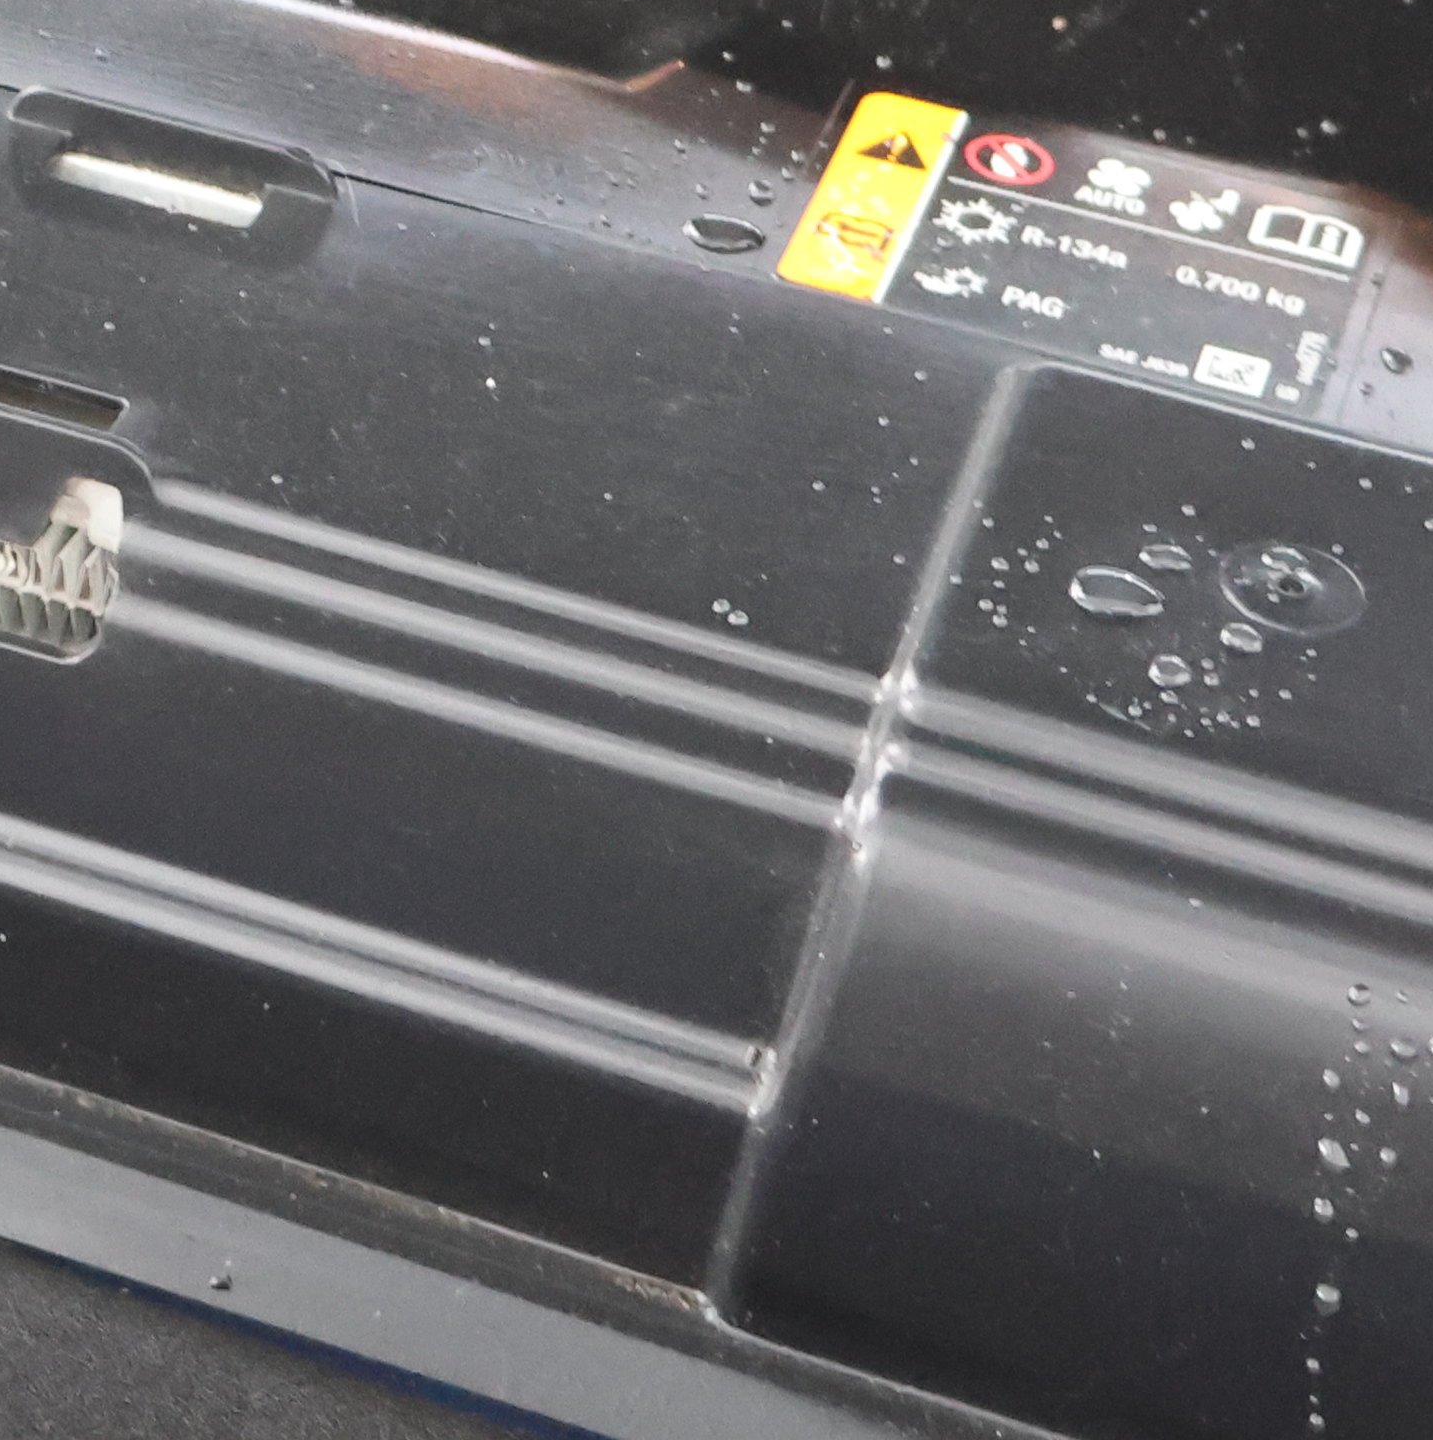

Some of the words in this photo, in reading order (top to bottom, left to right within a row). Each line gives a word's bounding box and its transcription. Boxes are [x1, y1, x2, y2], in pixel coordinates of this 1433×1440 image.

[1073, 183, 1147, 217] AUTO
[1018, 225, 1129, 270] R-134a
[1174, 264, 1261, 302] 0.700
[1265, 286, 1307, 318] kg
[1001, 283, 1067, 319] PAG
